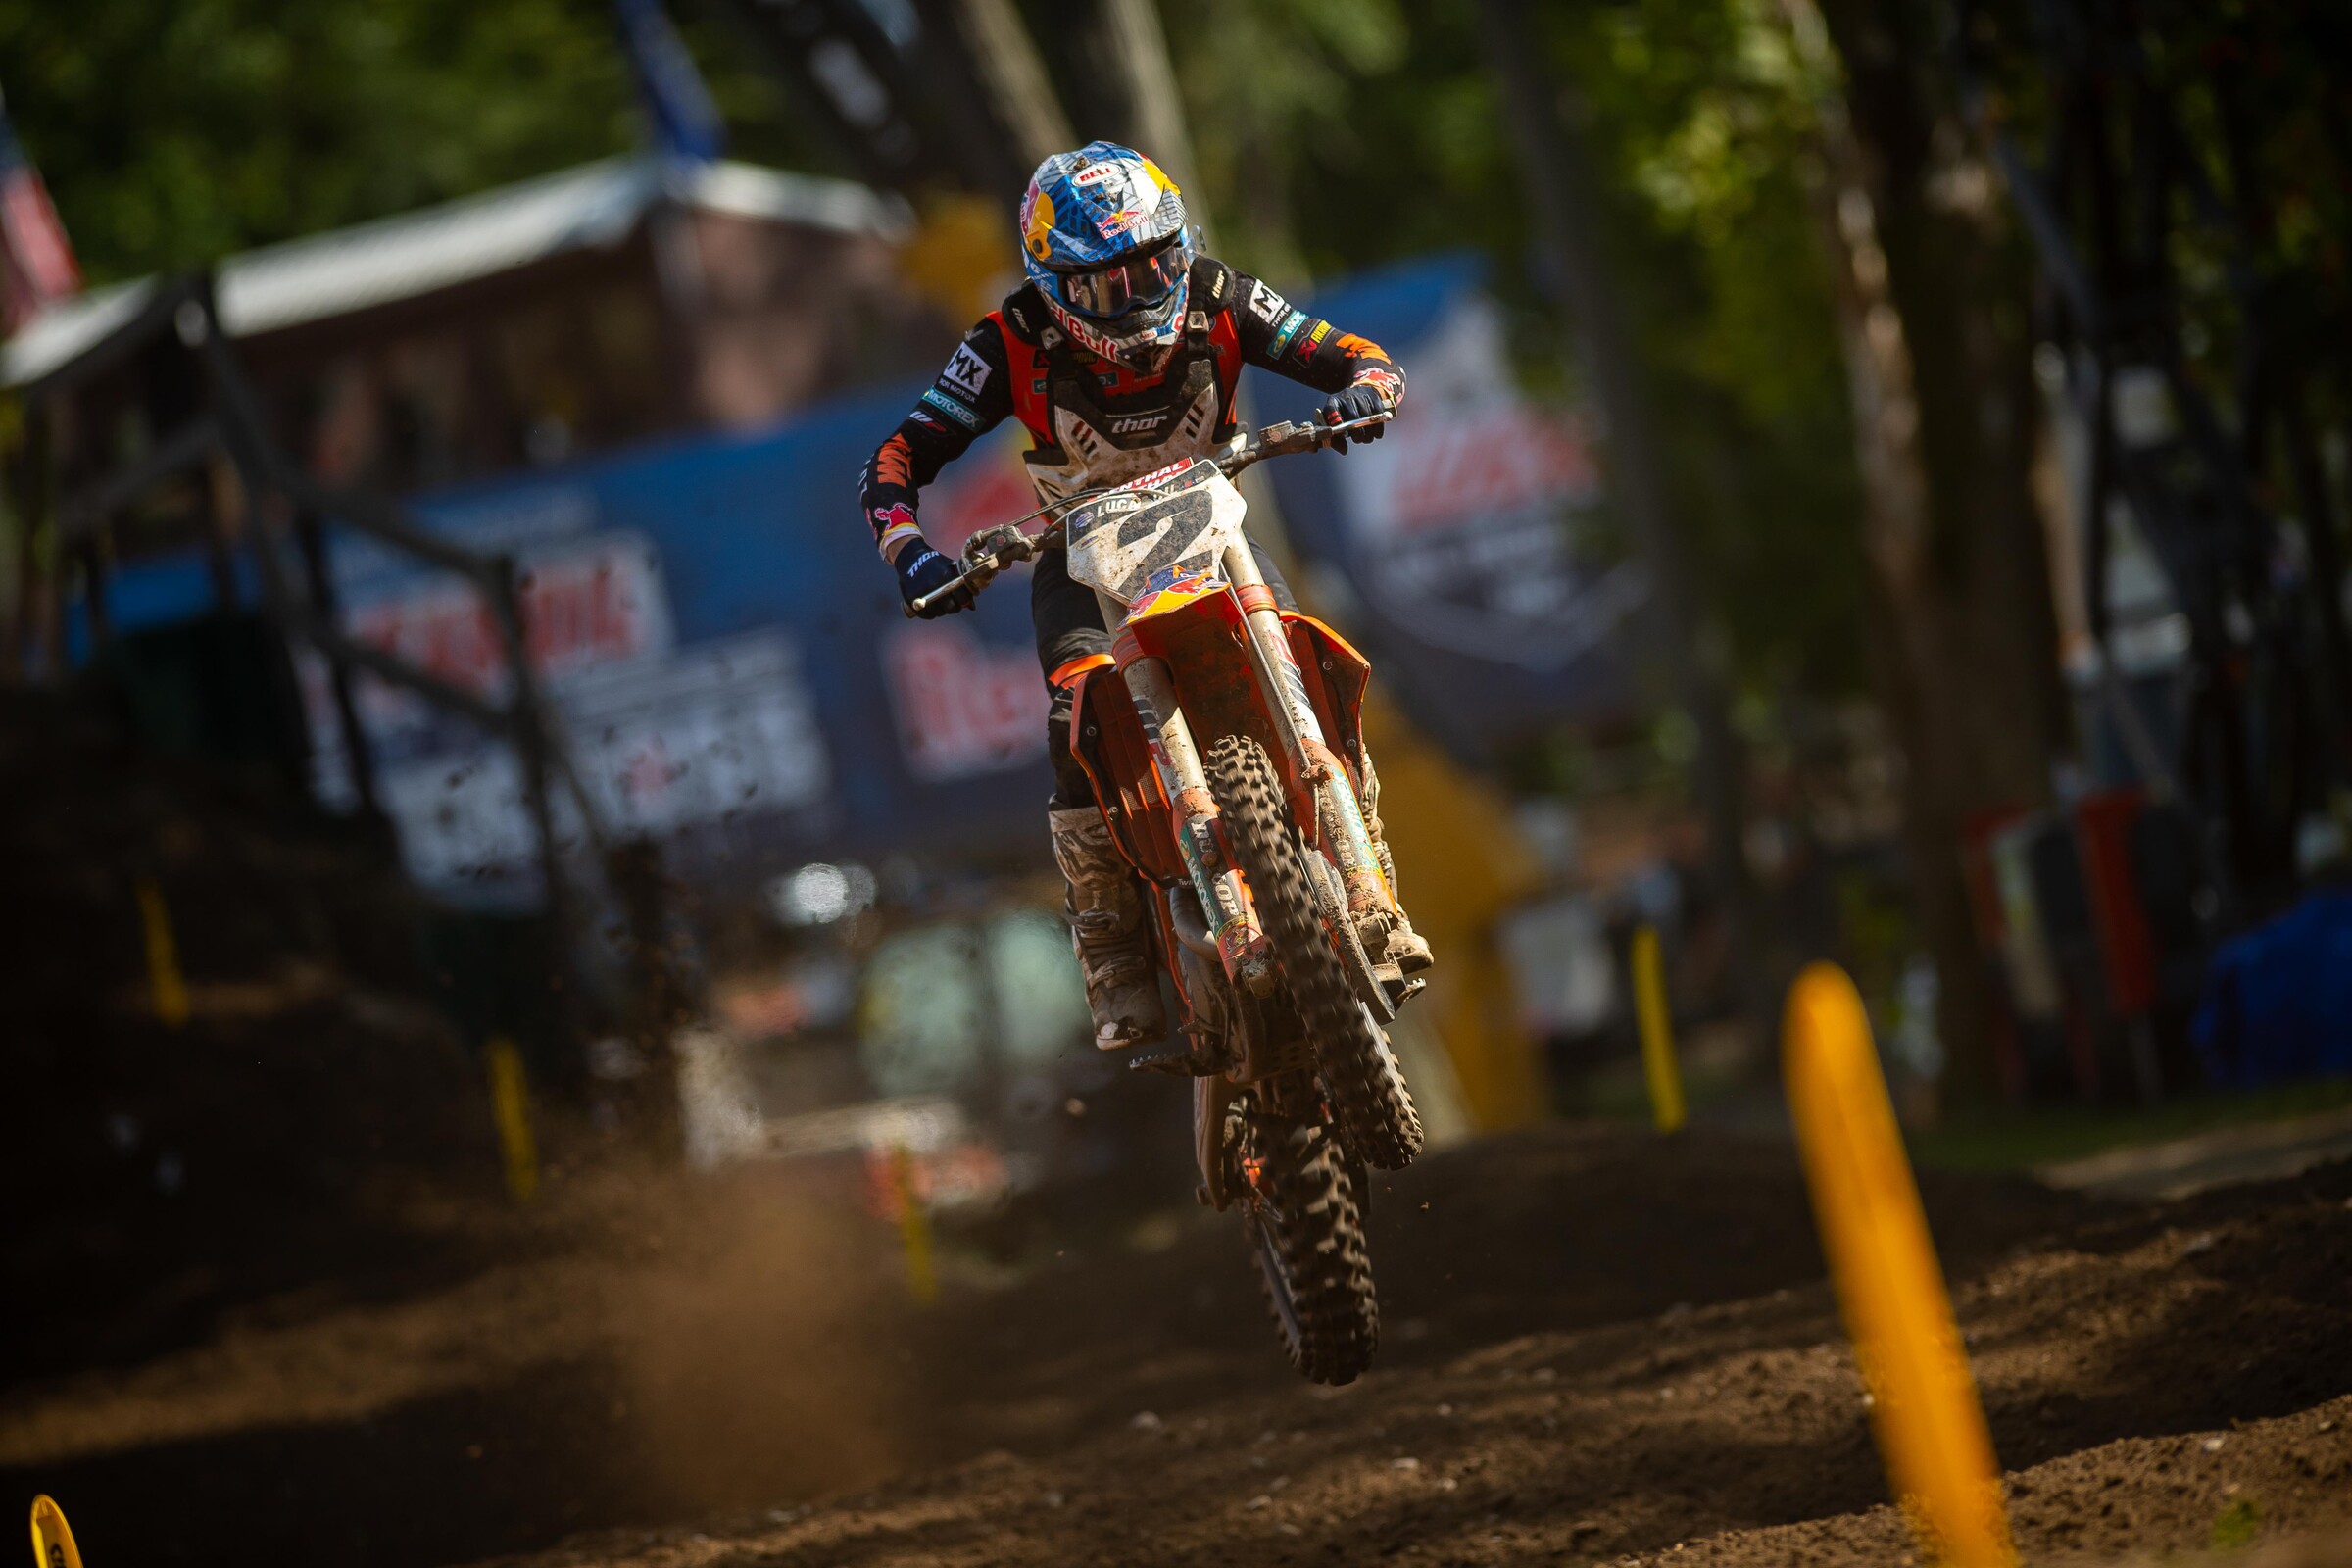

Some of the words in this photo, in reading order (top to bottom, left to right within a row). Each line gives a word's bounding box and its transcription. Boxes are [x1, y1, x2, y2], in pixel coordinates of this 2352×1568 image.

[1079, 167, 1115, 183] BELL
[1101, 222, 1125, 240] Red
[1126, 215, 1150, 233] Bull
[1211, 270, 1226, 300] thor
[1067, 318, 1118, 363] Bull
[947, 346, 983, 387] MX
[927, 388, 979, 429] MOTOREX
[1111, 413, 1168, 434] thor
[1103, 462, 1185, 496] ENTHAL
[1097, 498, 1142, 518] LUCA
[1117, 489, 1214, 594] 2
[906, 550, 941, 579] THOR
[1185, 858, 1220, 932] MOTOREX
